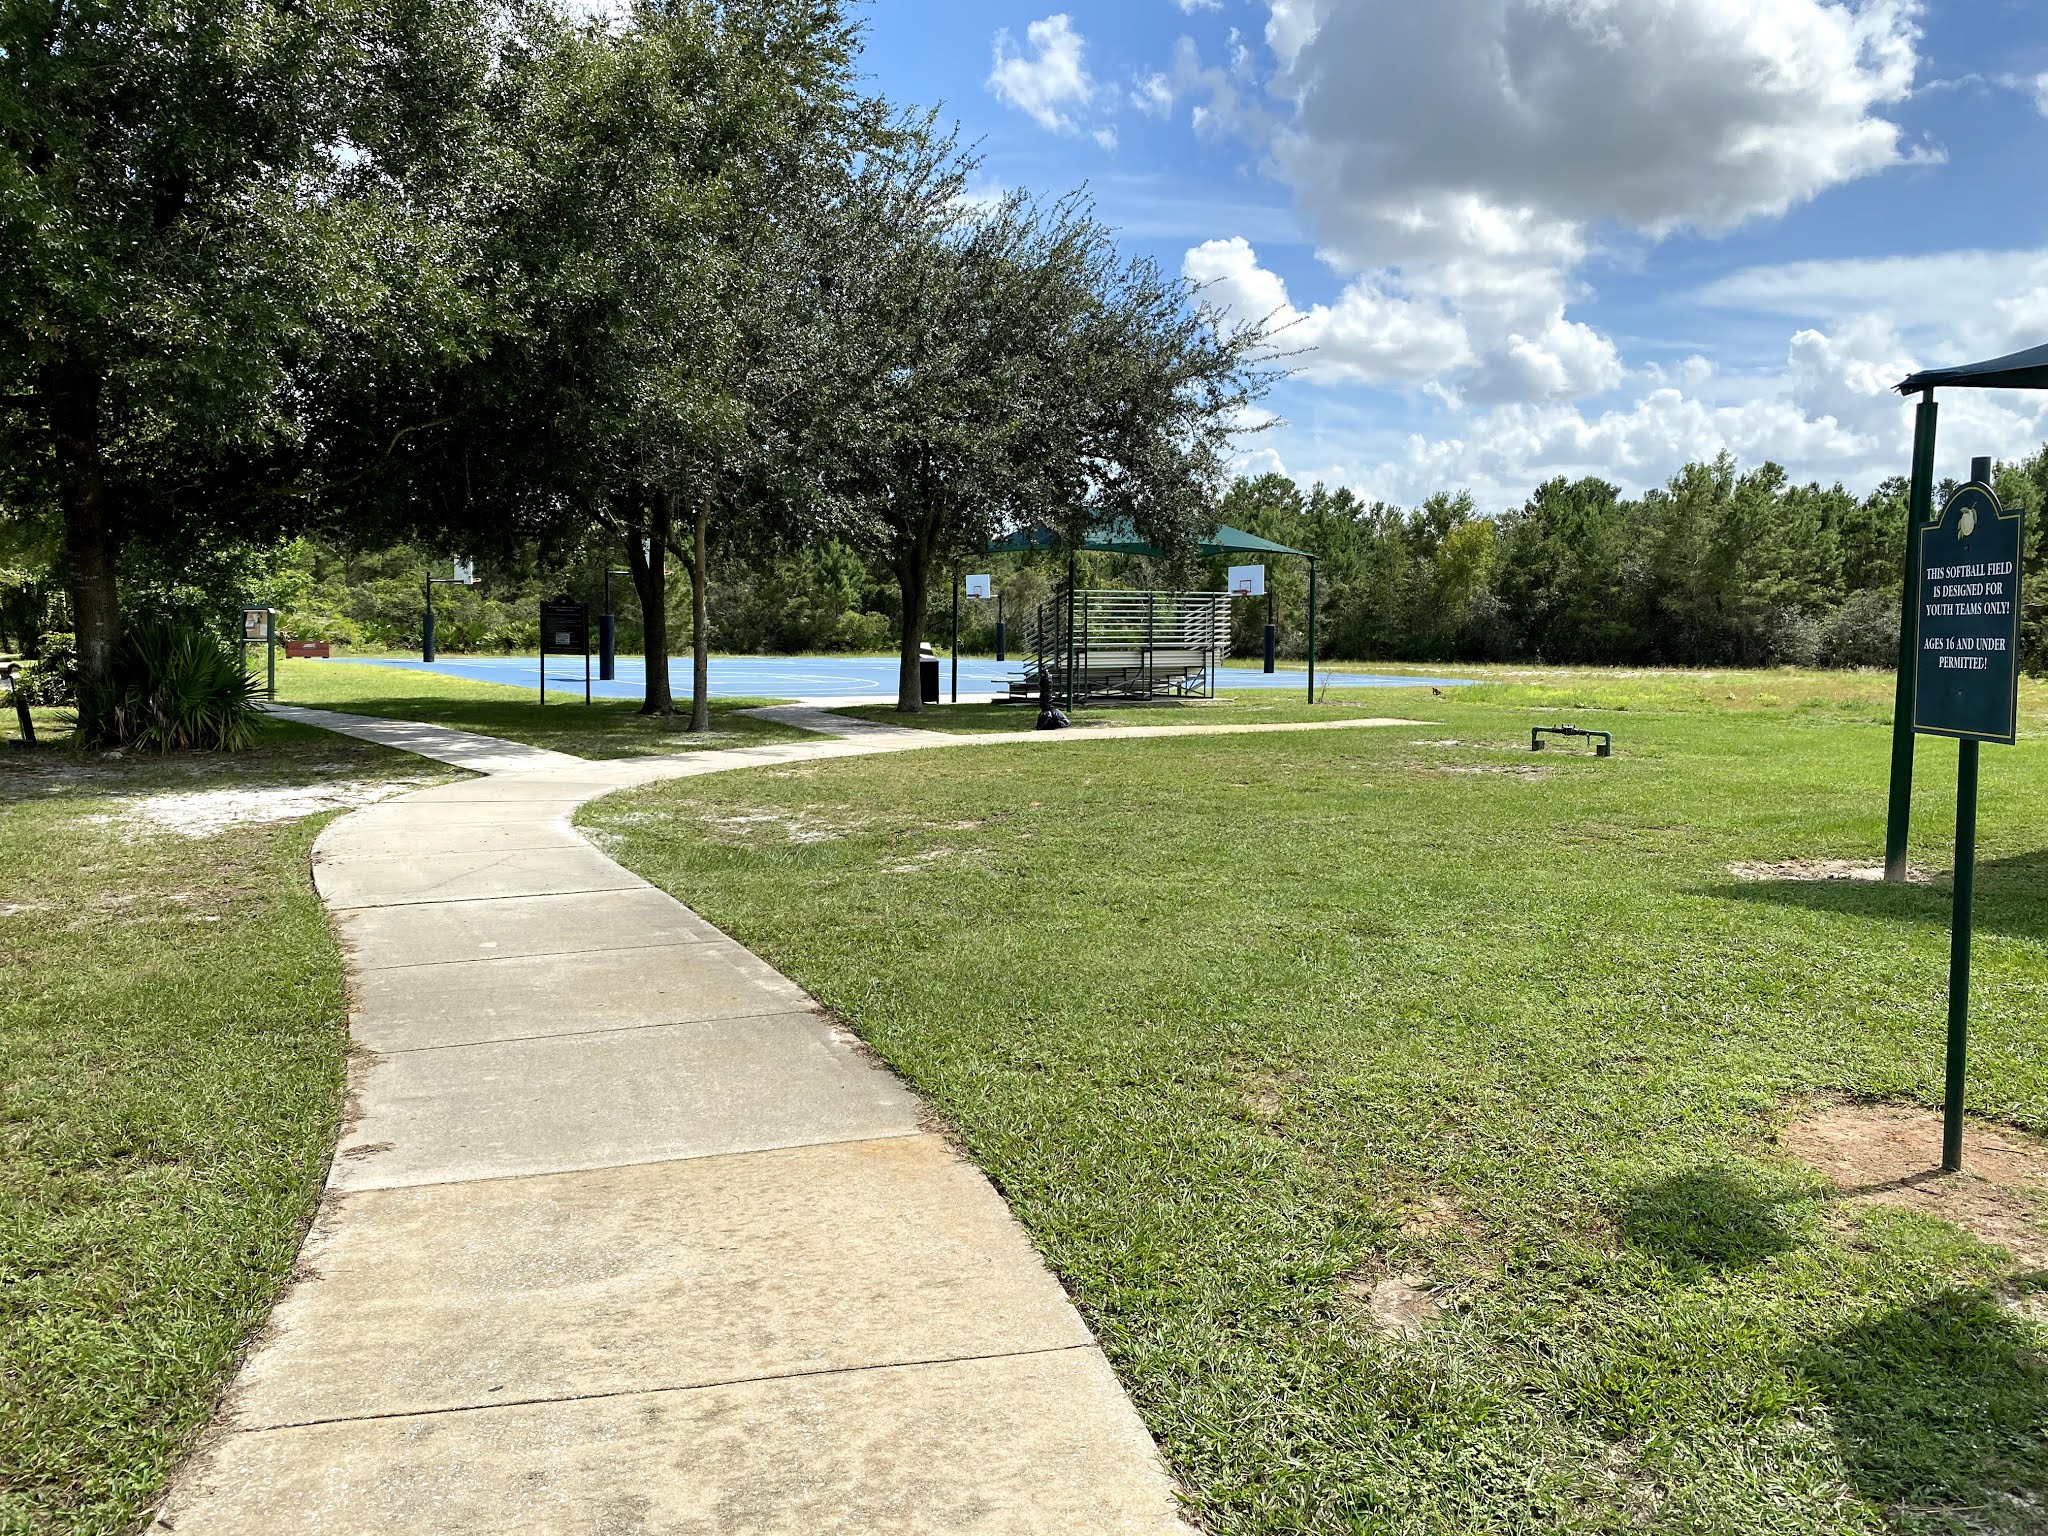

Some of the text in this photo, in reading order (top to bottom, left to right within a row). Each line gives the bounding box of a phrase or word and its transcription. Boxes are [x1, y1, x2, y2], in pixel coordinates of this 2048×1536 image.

[1926, 561, 2013, 580] THIS SOFTBALL FIELD
[1933, 581, 2003, 598] IS DESIGNED FOR
[1925, 601, 2010, 616] YOUTH TEAMS ONLY!
[1923, 635, 2006, 651] AGES 16 AND UNDER
[1938, 656, 1988, 670] PERMITTED!
